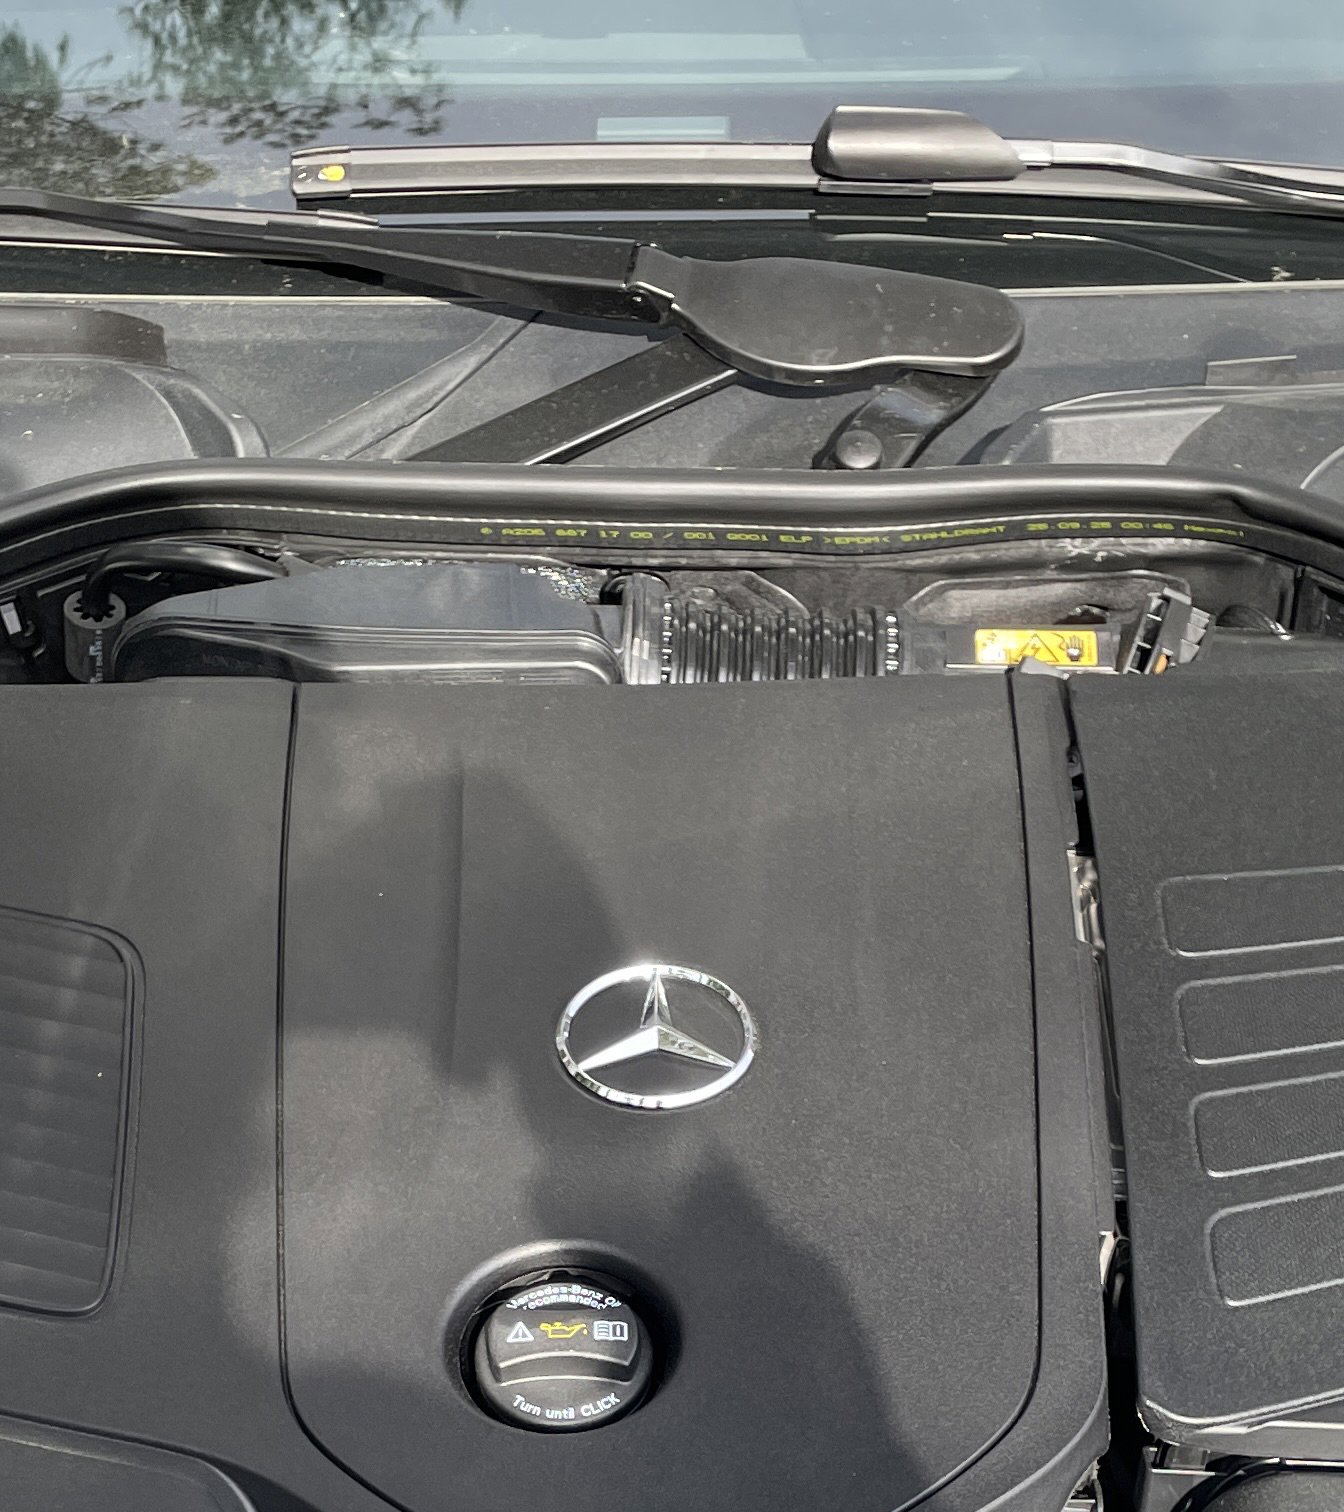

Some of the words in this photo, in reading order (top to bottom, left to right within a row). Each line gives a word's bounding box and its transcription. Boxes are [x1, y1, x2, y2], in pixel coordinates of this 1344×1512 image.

[512, 1394, 541, 1417] Turn
[545, 1407, 575, 1420] until
[580, 1392, 621, 1417] CLICK
